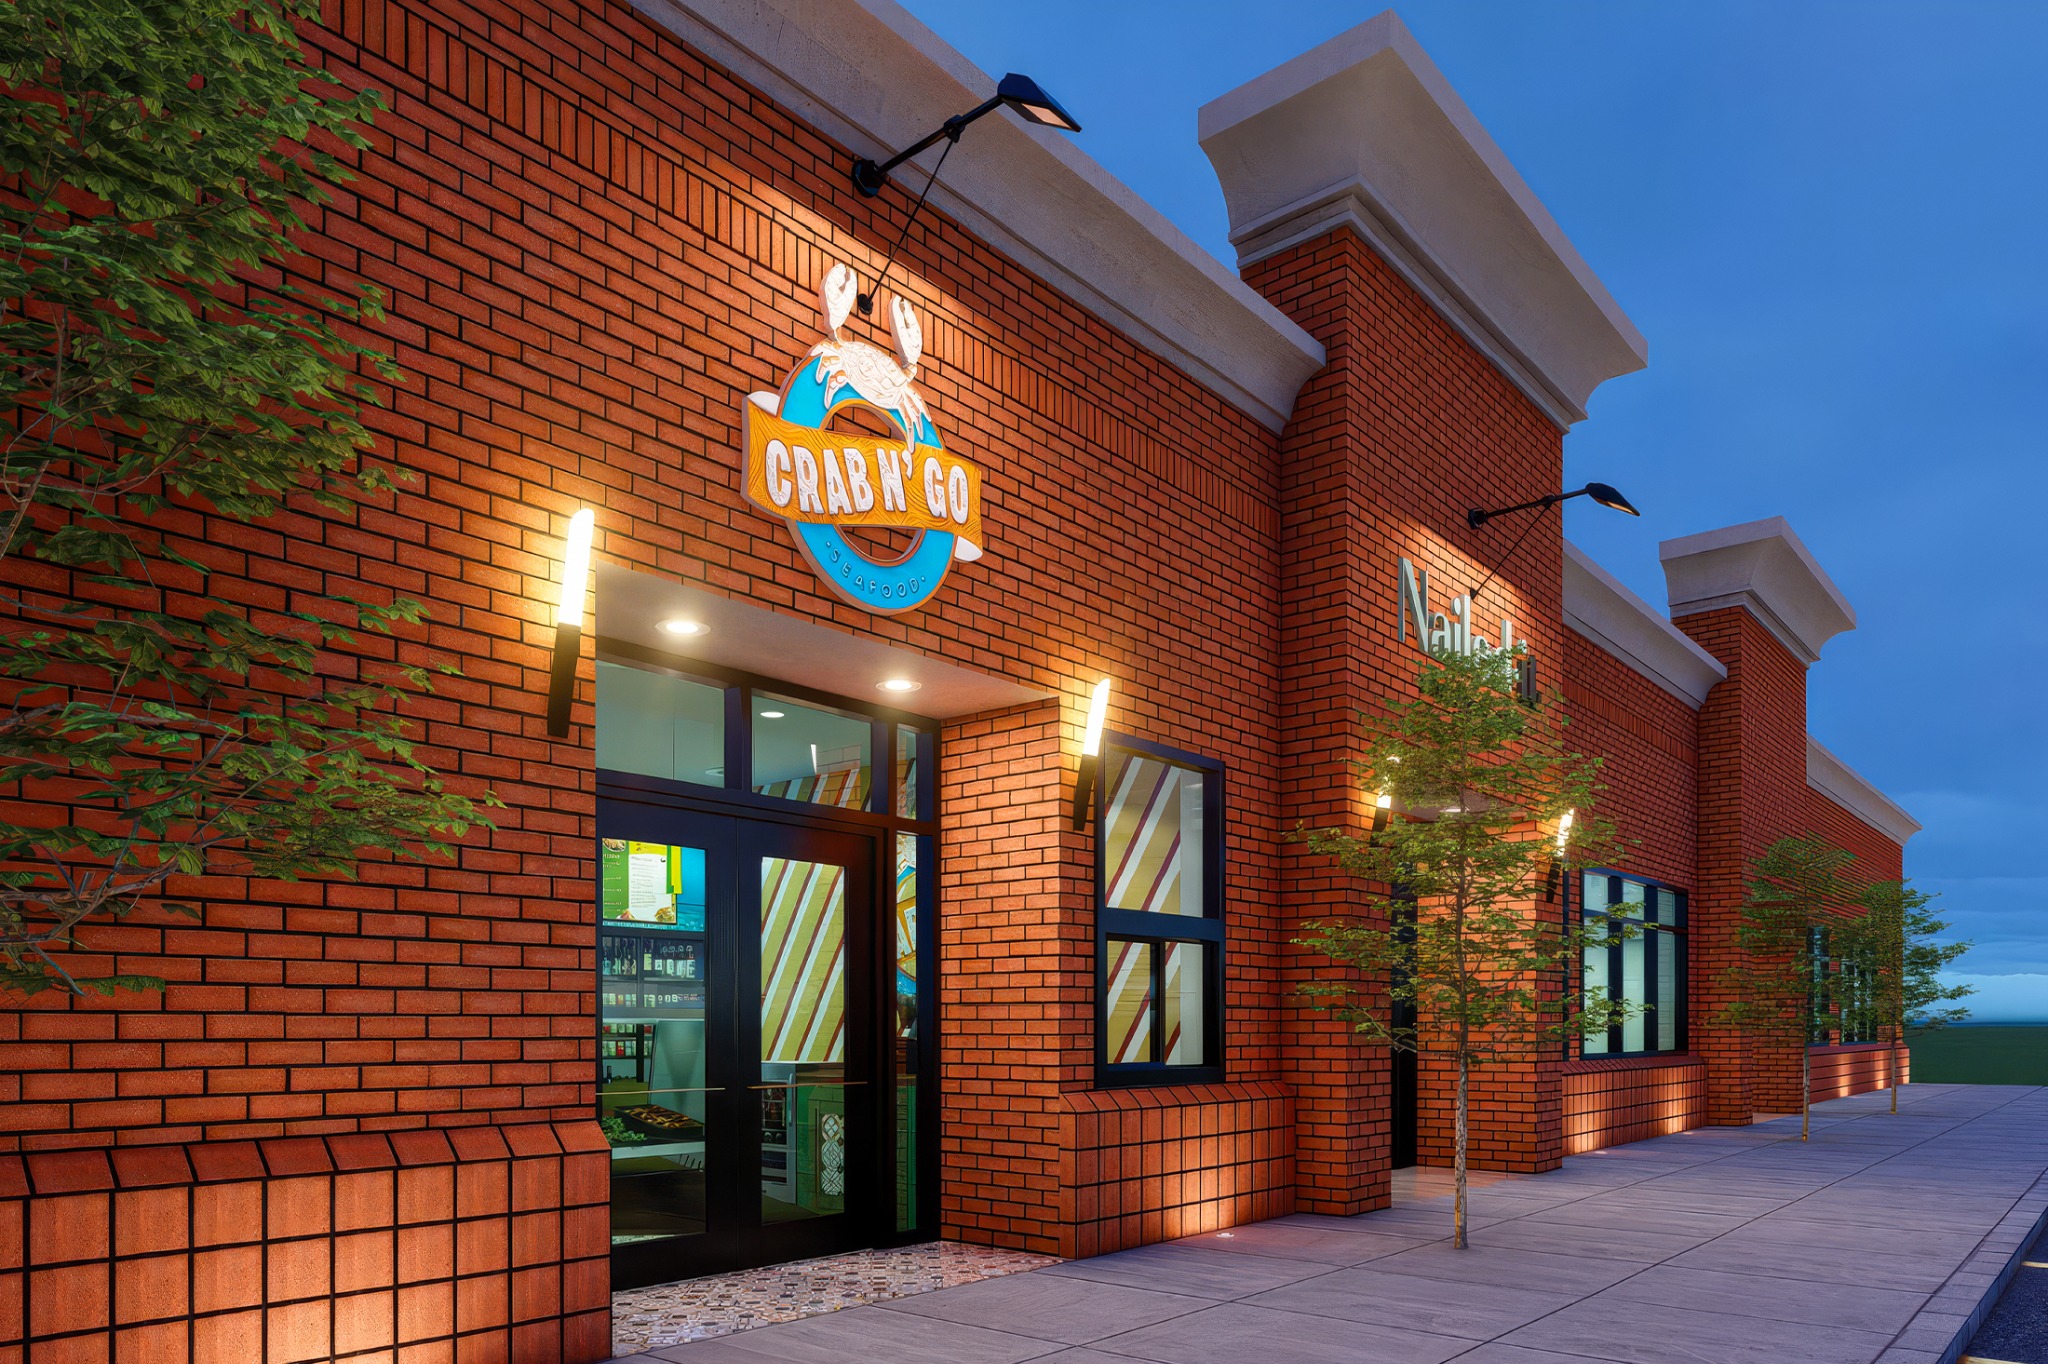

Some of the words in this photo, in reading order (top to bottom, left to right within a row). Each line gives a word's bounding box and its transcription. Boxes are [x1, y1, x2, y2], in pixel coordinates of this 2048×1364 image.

[766, 439, 873, 514] CRAB
[923, 456, 970, 525] GO
[830, 547, 920, 598] SEAFOOD
